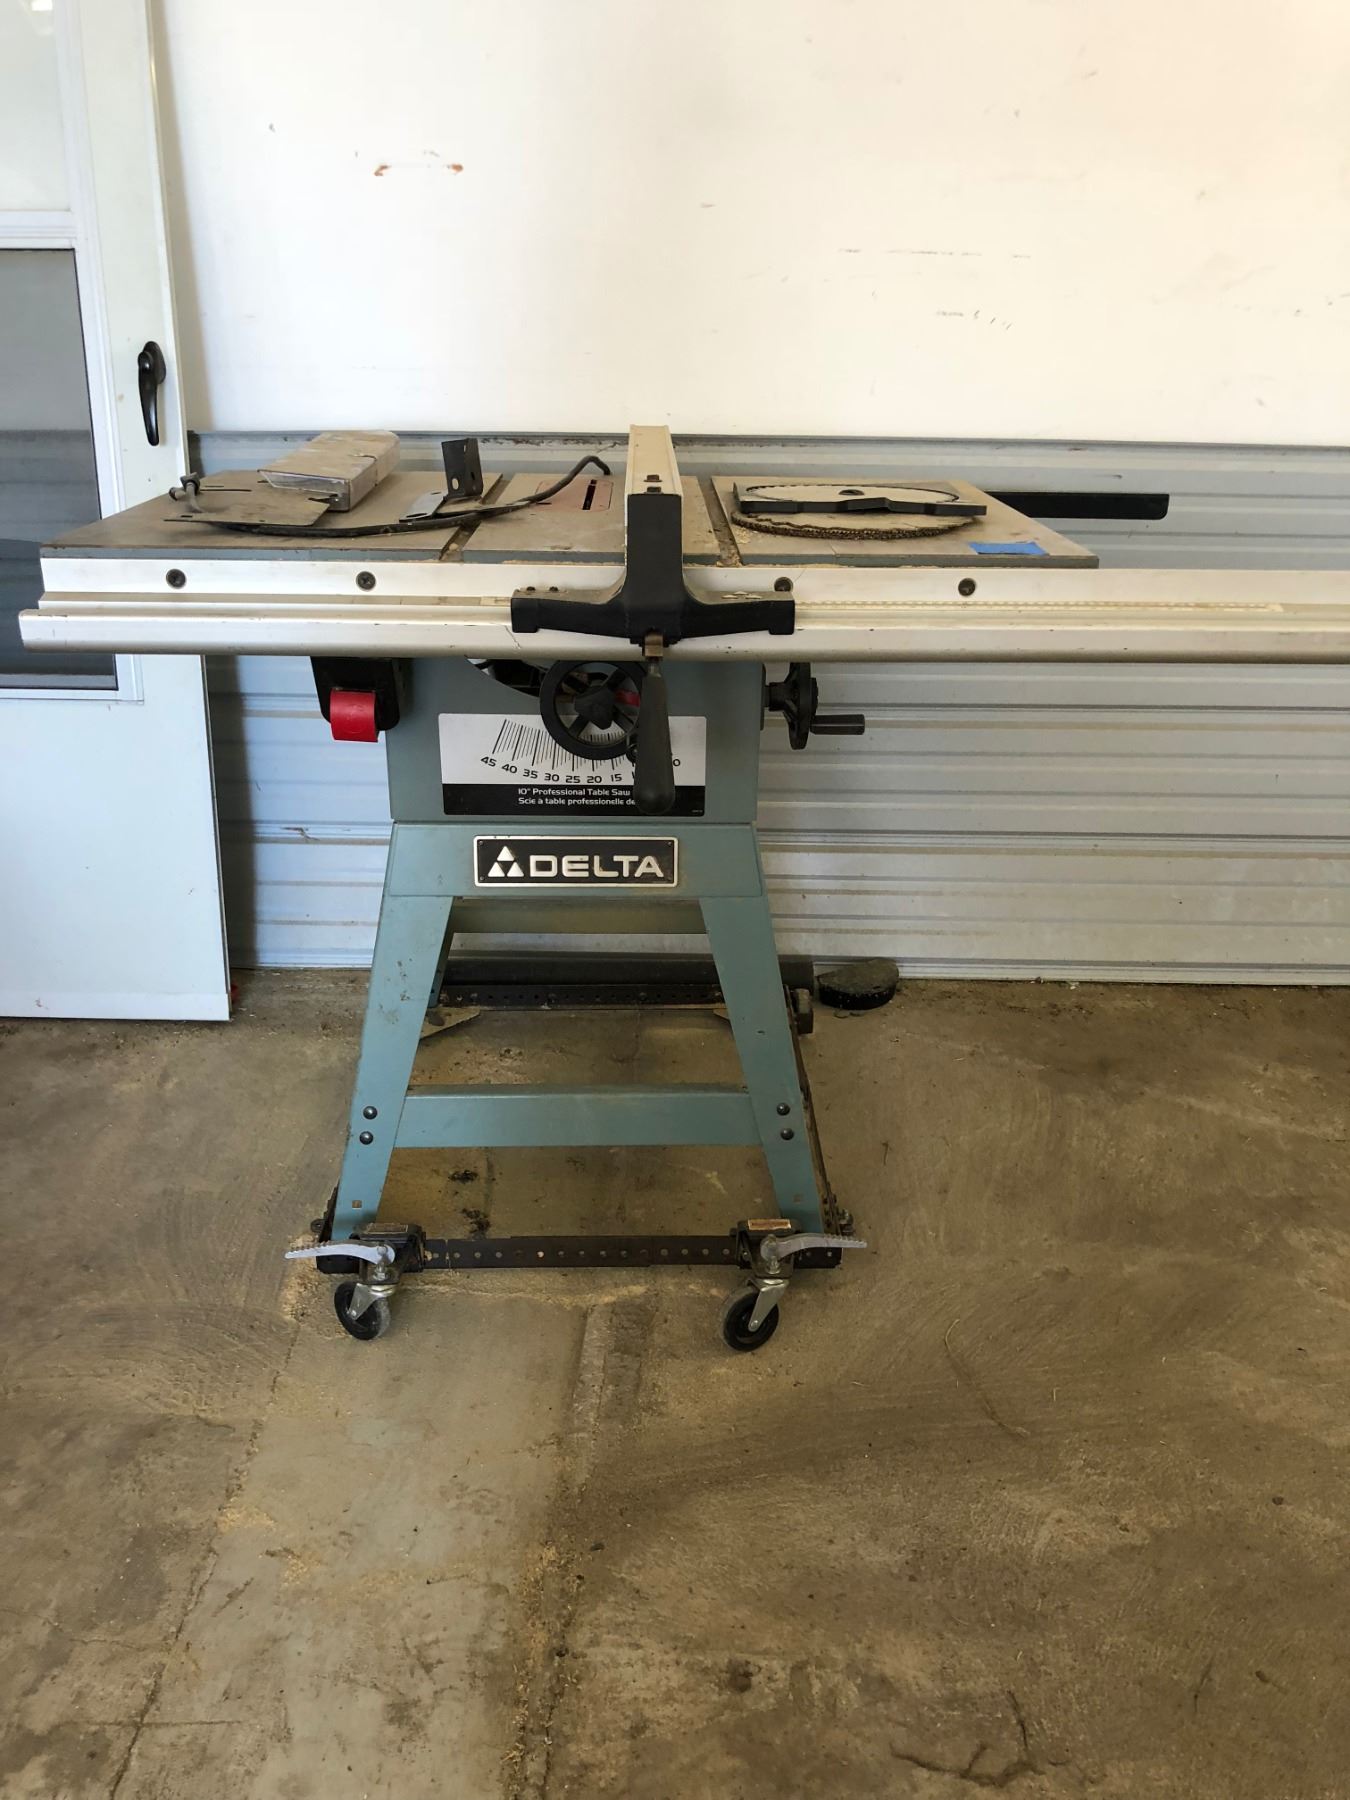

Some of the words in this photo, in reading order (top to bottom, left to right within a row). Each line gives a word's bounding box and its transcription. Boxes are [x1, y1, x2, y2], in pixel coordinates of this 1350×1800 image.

[481, 756, 497, 767] 45
[501, 763, 518, 774] 40
[522, 768, 539, 779] 35
[544, 772, 560, 782] 30
[565, 775, 581, 784] 25
[586, 775, 602, 784] 20
[611, 773, 623, 782] 15
[532, 788, 586, 796] Professional
[587, 788, 610, 796] Table
[611, 788, 631, 796] Saw
[518, 797, 536, 805] Scie
[545, 797, 566, 805] table
[529, 855, 665, 878] DELTA
